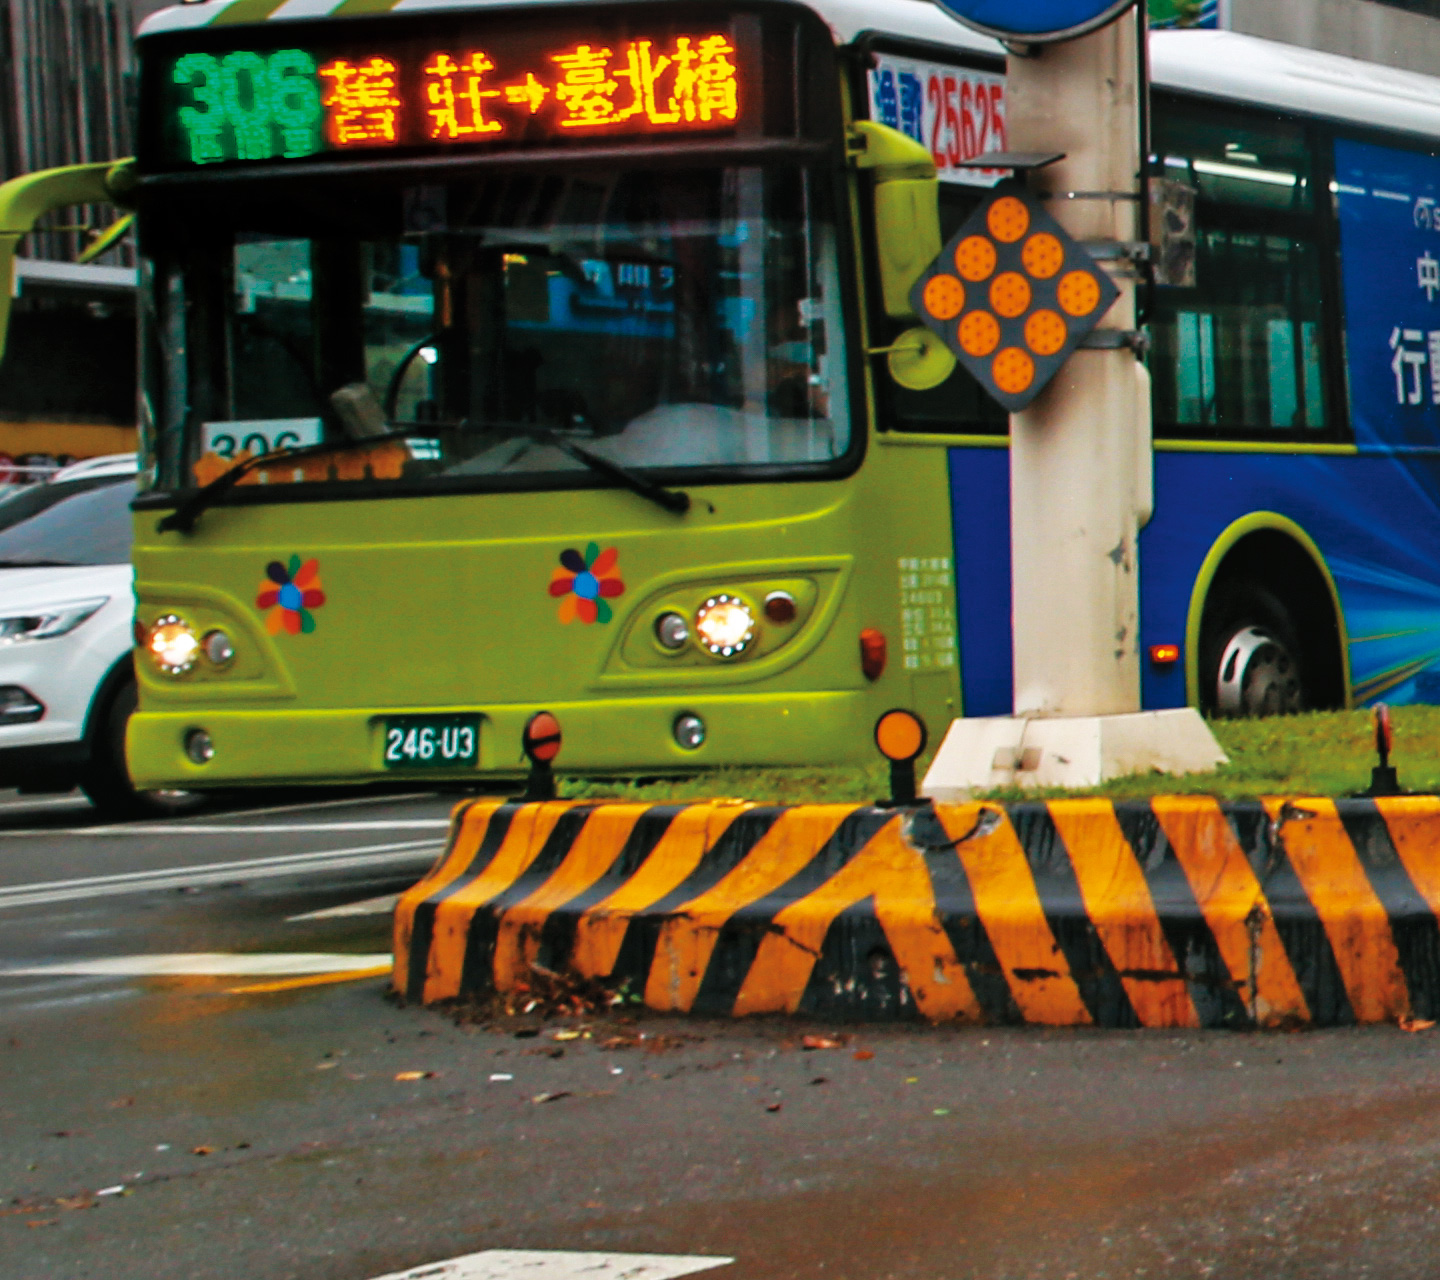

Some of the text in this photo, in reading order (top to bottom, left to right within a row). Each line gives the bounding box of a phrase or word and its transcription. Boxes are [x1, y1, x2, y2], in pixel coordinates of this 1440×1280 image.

[173, 48, 320, 130] 306
[551, 33, 738, 130] 臺北橋
[386, 725, 474, 759] 246-U3
